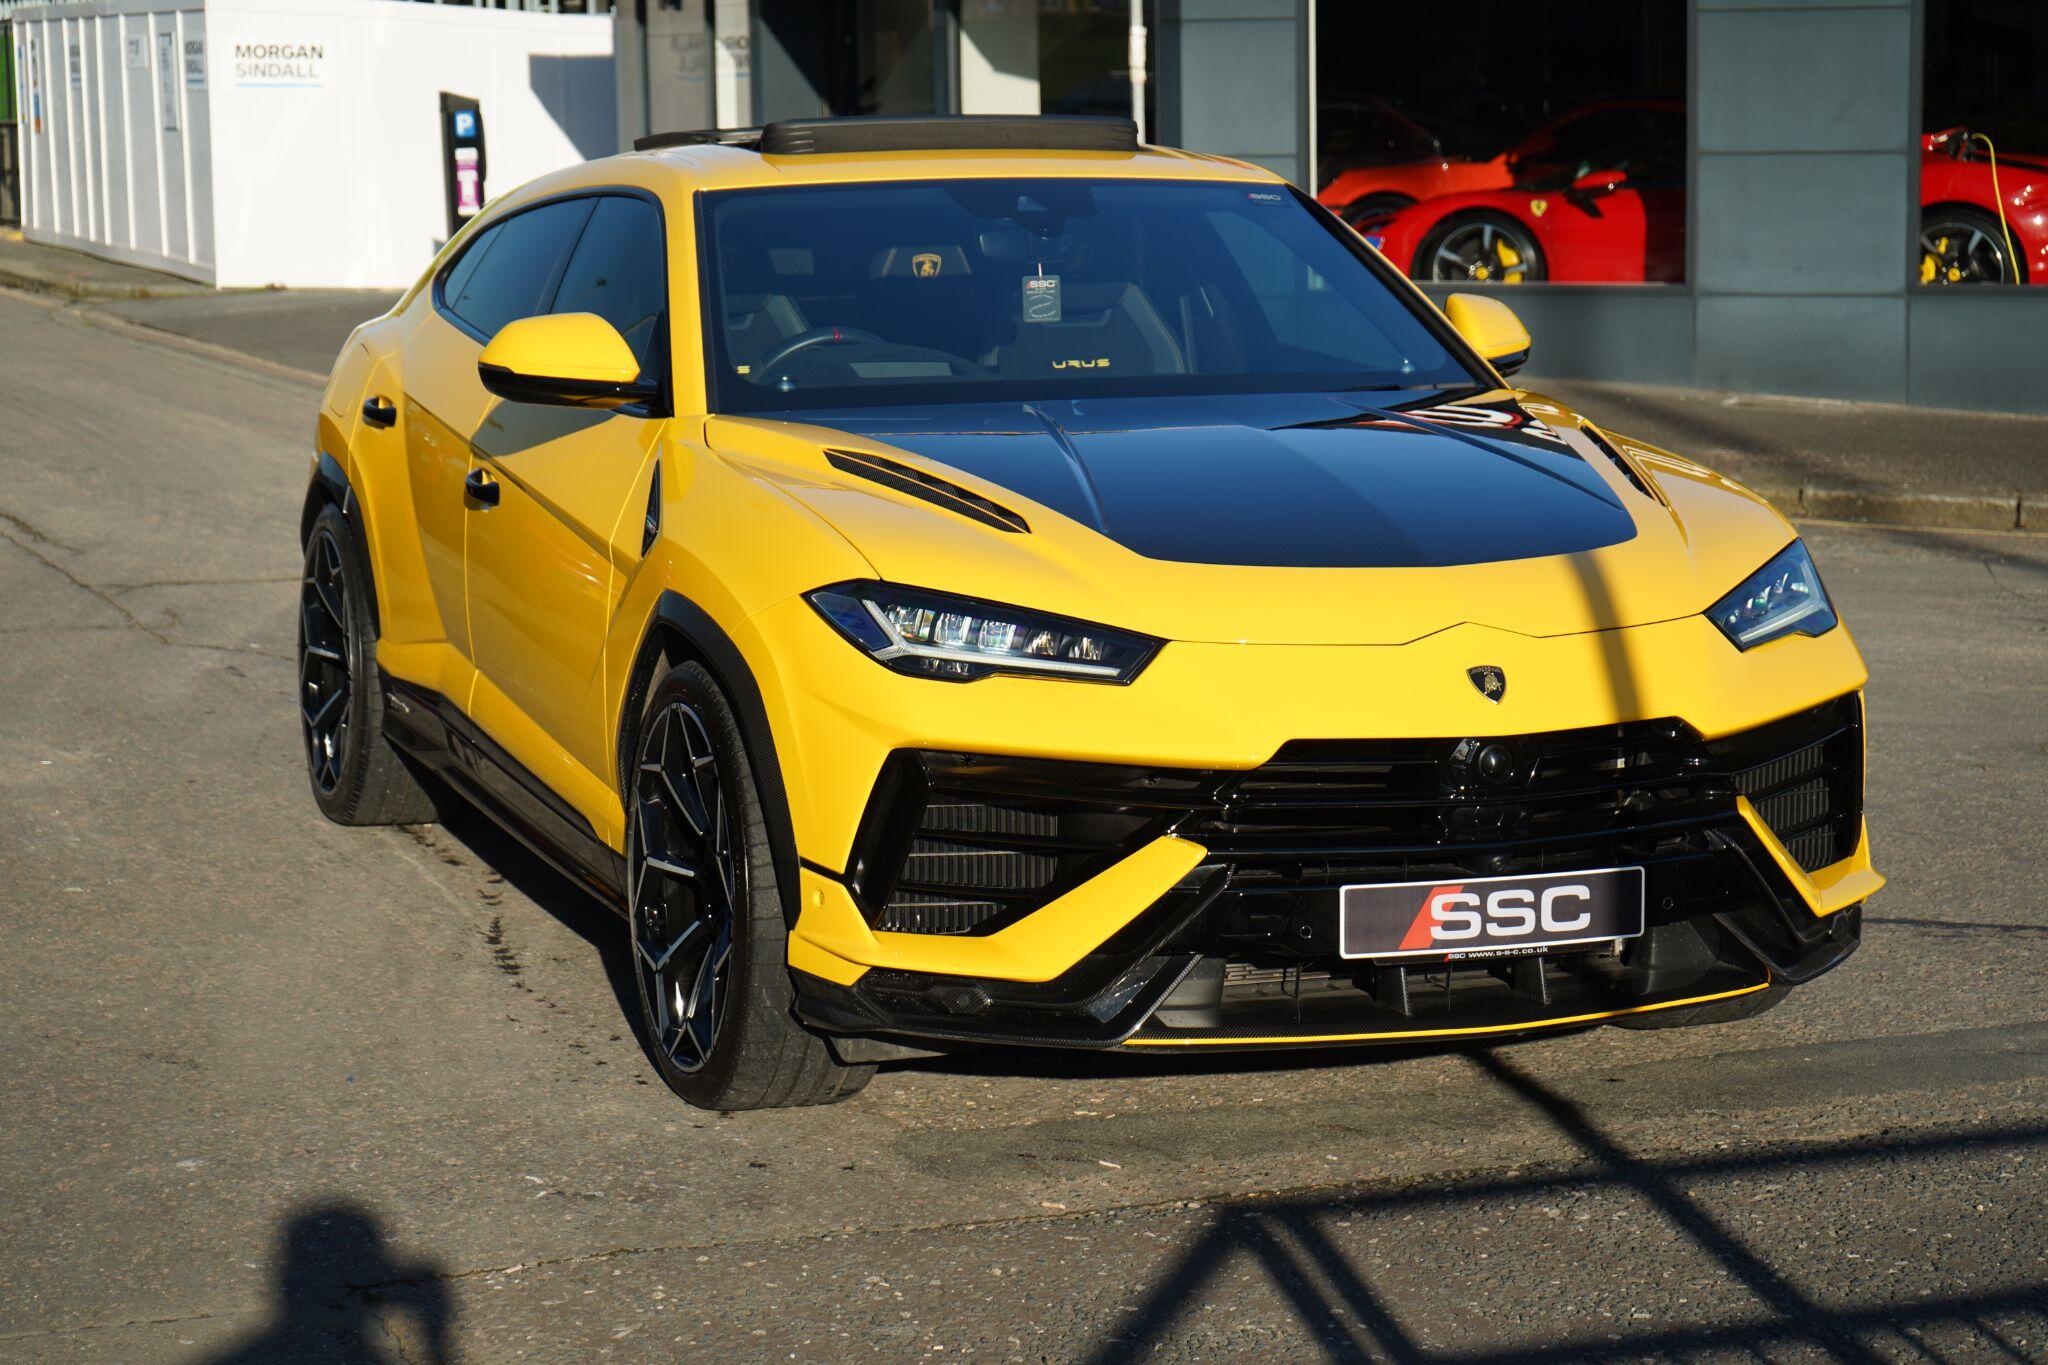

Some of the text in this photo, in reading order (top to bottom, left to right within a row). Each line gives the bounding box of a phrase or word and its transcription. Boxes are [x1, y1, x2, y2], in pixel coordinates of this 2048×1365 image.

[235, 44, 323, 59] MORGAN
[235, 62, 319, 78] SINDALL
[456, 113, 474, 137] P
[1030, 280, 1056, 288] SSC
[1052, 358, 1110, 369] URUS
[1430, 885, 1590, 940] SSC
